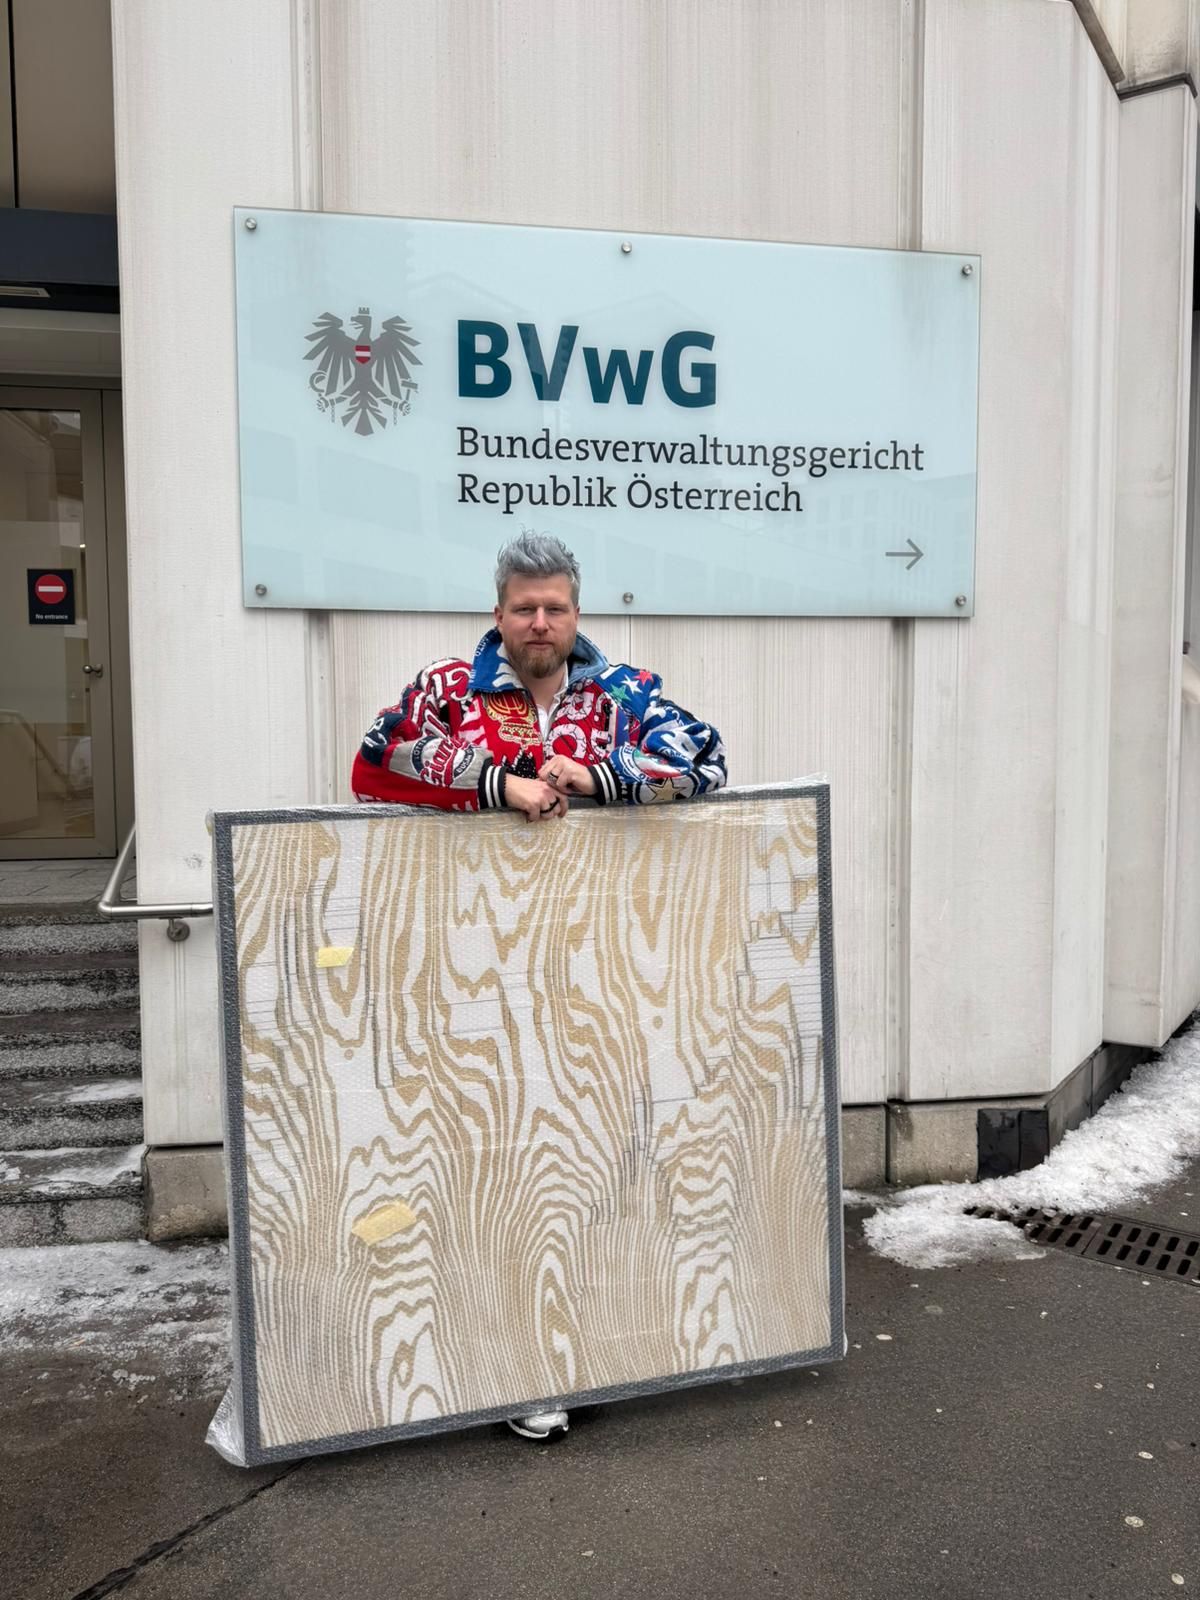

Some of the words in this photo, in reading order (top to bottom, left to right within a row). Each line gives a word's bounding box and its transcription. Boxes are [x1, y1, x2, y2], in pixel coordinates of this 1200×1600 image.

[457, 319, 717, 408] BVwG
[457, 427, 925, 477] Bundesverwaltungsgericht
[457, 474, 617, 514] Republik
[627, 473, 804, 512] Österreich
